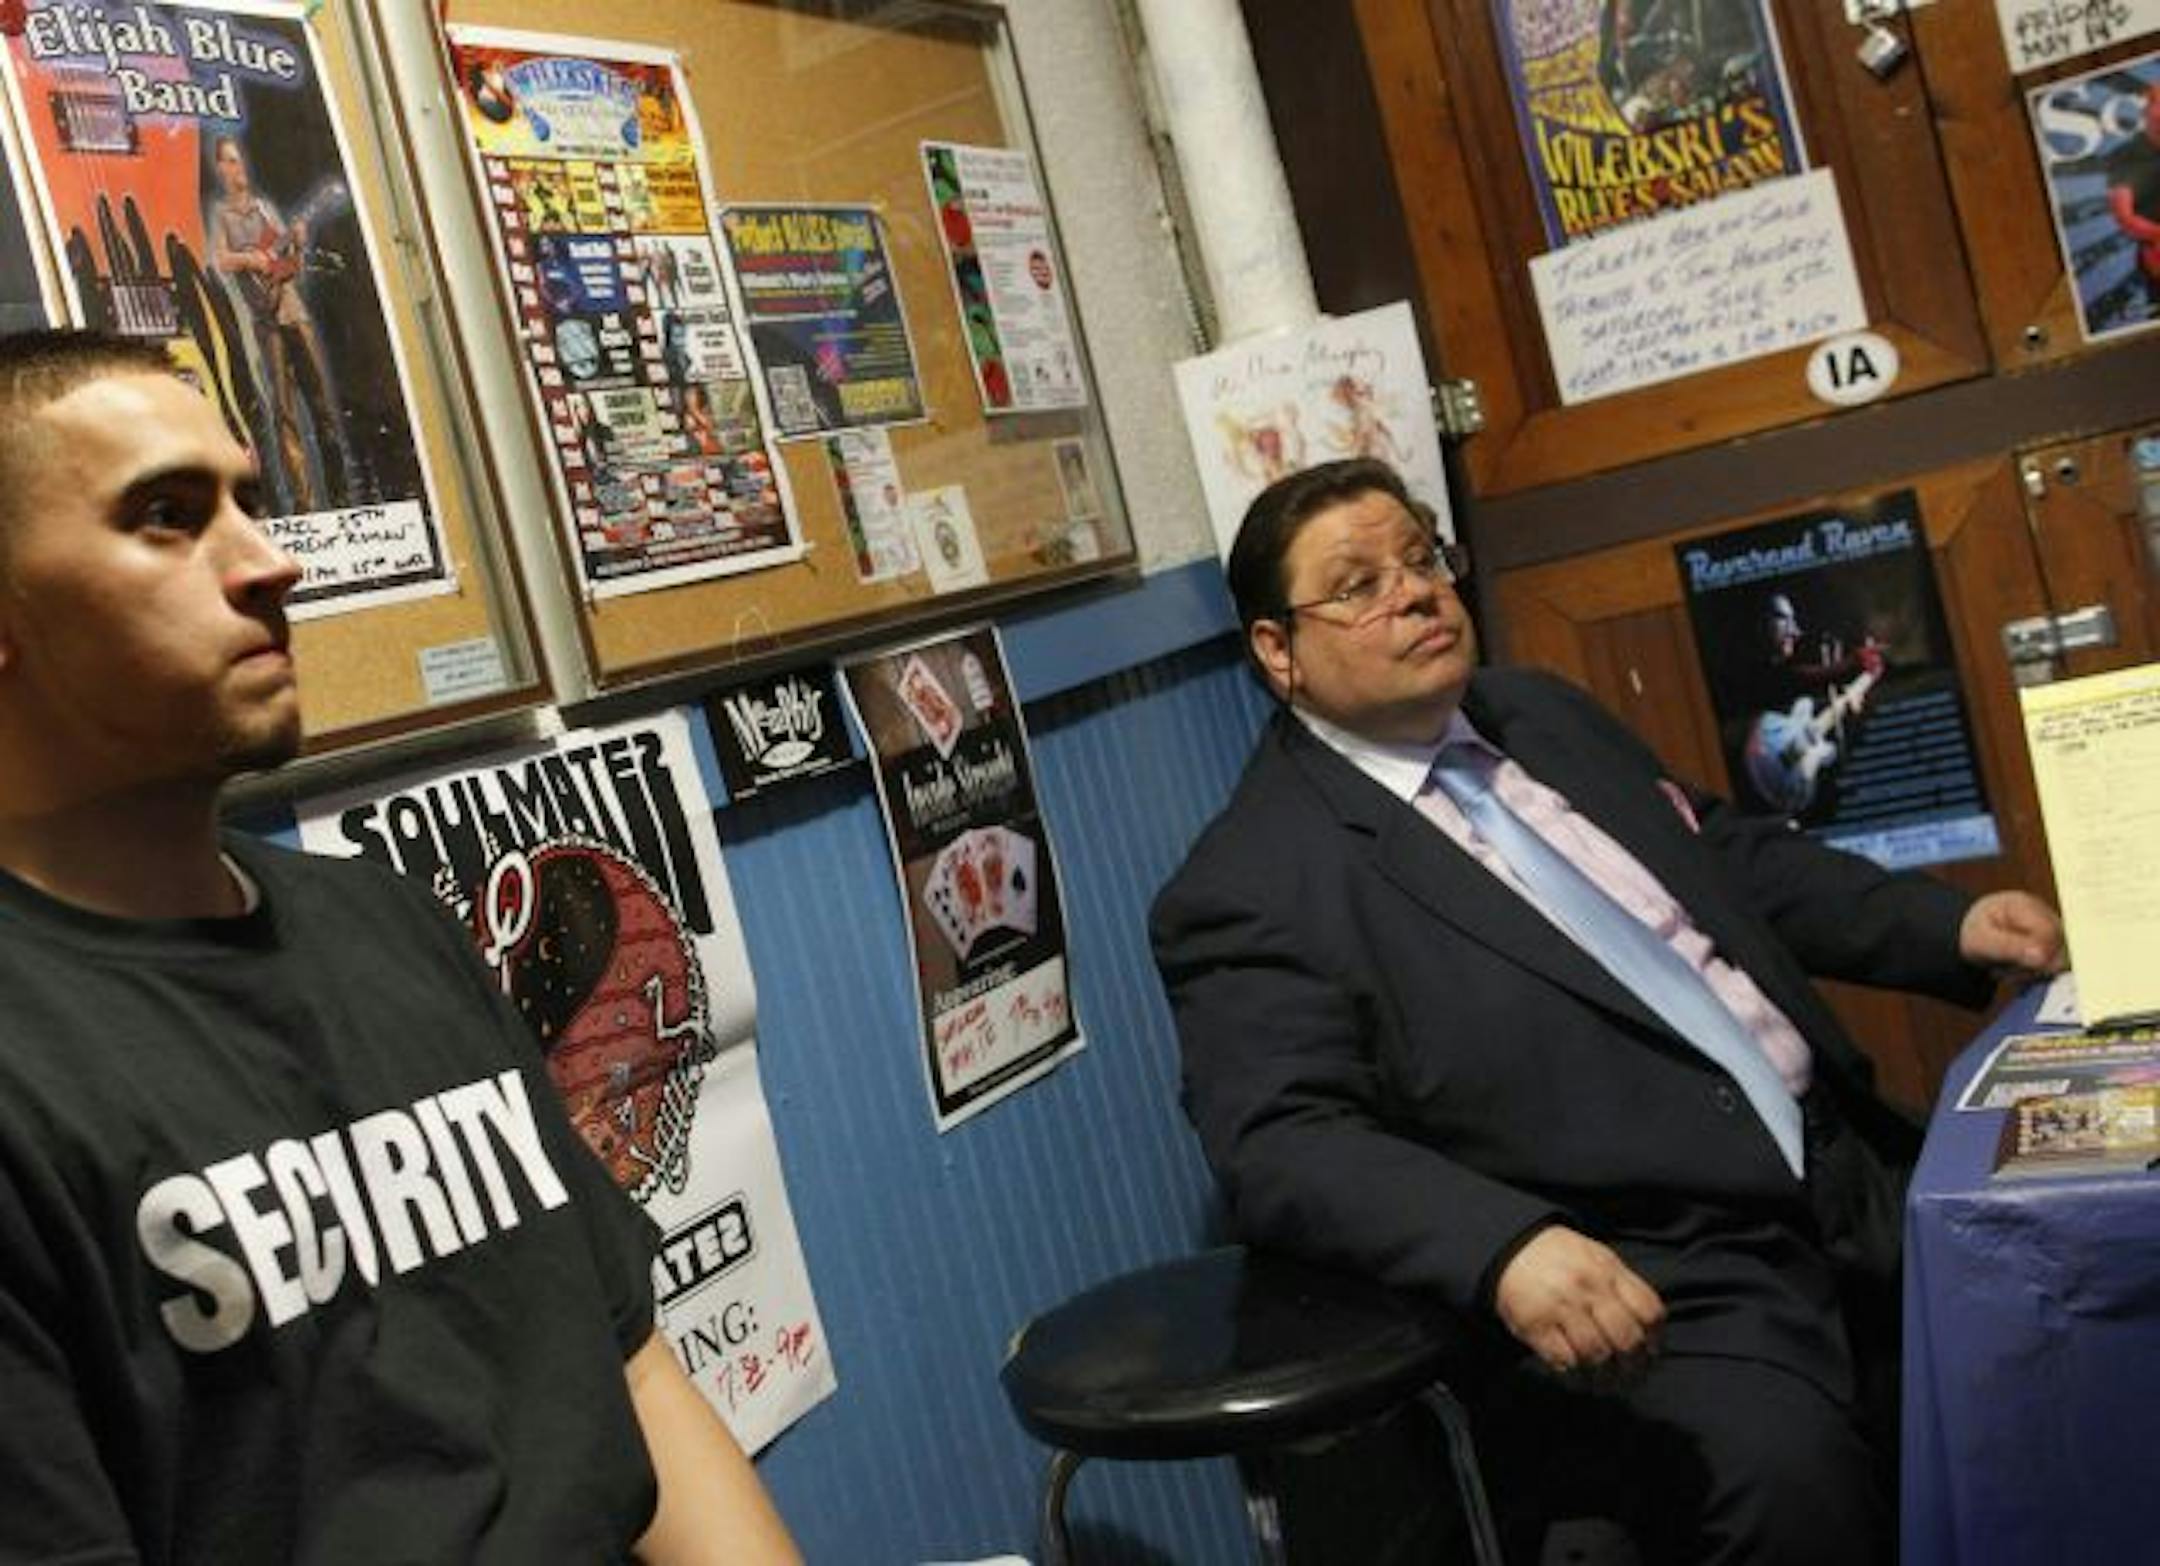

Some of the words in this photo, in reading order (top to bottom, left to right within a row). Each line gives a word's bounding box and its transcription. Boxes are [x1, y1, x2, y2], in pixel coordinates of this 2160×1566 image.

[24, 2, 176, 75] Elijah
[184, 17, 297, 79] Blue
[116, 69, 240, 120] Band
[1685, 531, 1816, 590] Reverend
[1820, 519, 1914, 562] Raven
[136, 1068, 569, 1353] SECURITY
